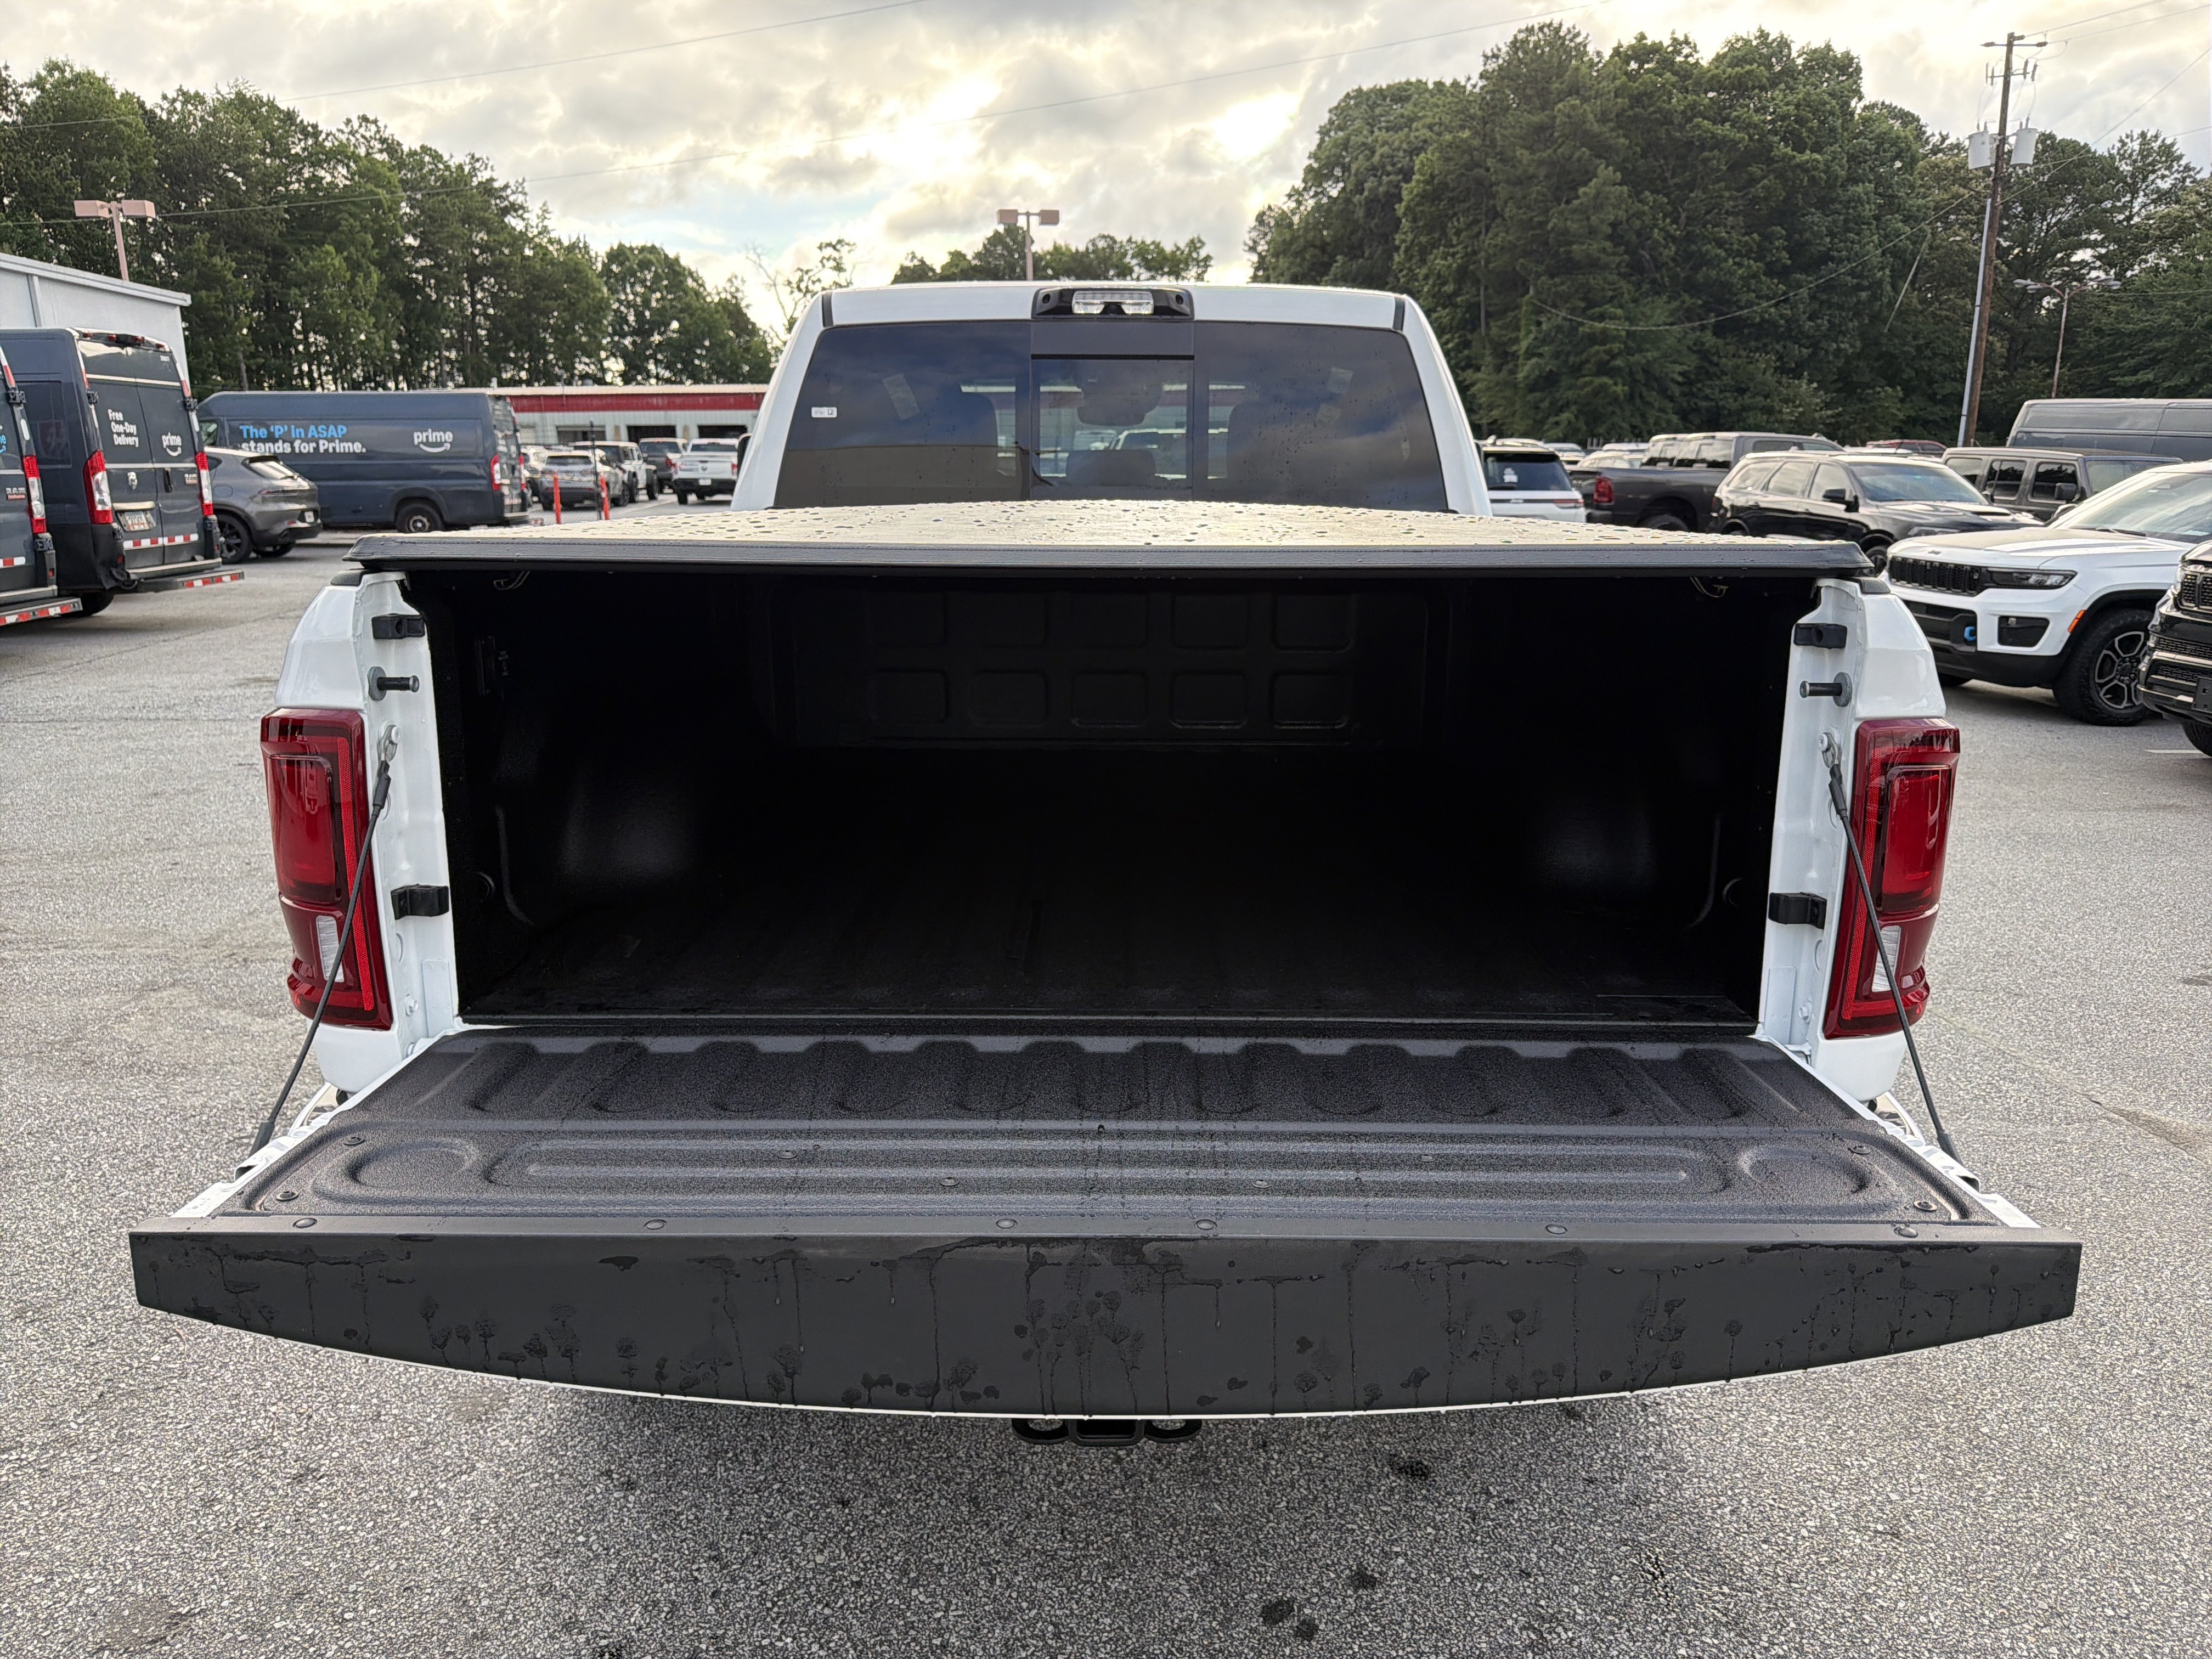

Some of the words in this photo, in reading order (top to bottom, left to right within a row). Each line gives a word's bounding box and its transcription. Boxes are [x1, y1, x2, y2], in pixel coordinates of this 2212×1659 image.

[108, 409, 124, 421] Free
[111, 421, 137, 435] One-Day
[239, 425, 268, 438] The
[308, 425, 347, 438] ASAP
[113, 433, 139, 448] Delivery
[161, 432, 182, 448] prime
[413, 428, 453, 445] prime
[241, 439, 292, 454] stands
[294, 439, 317, 453] for
[319, 439, 366, 454] Prime.
